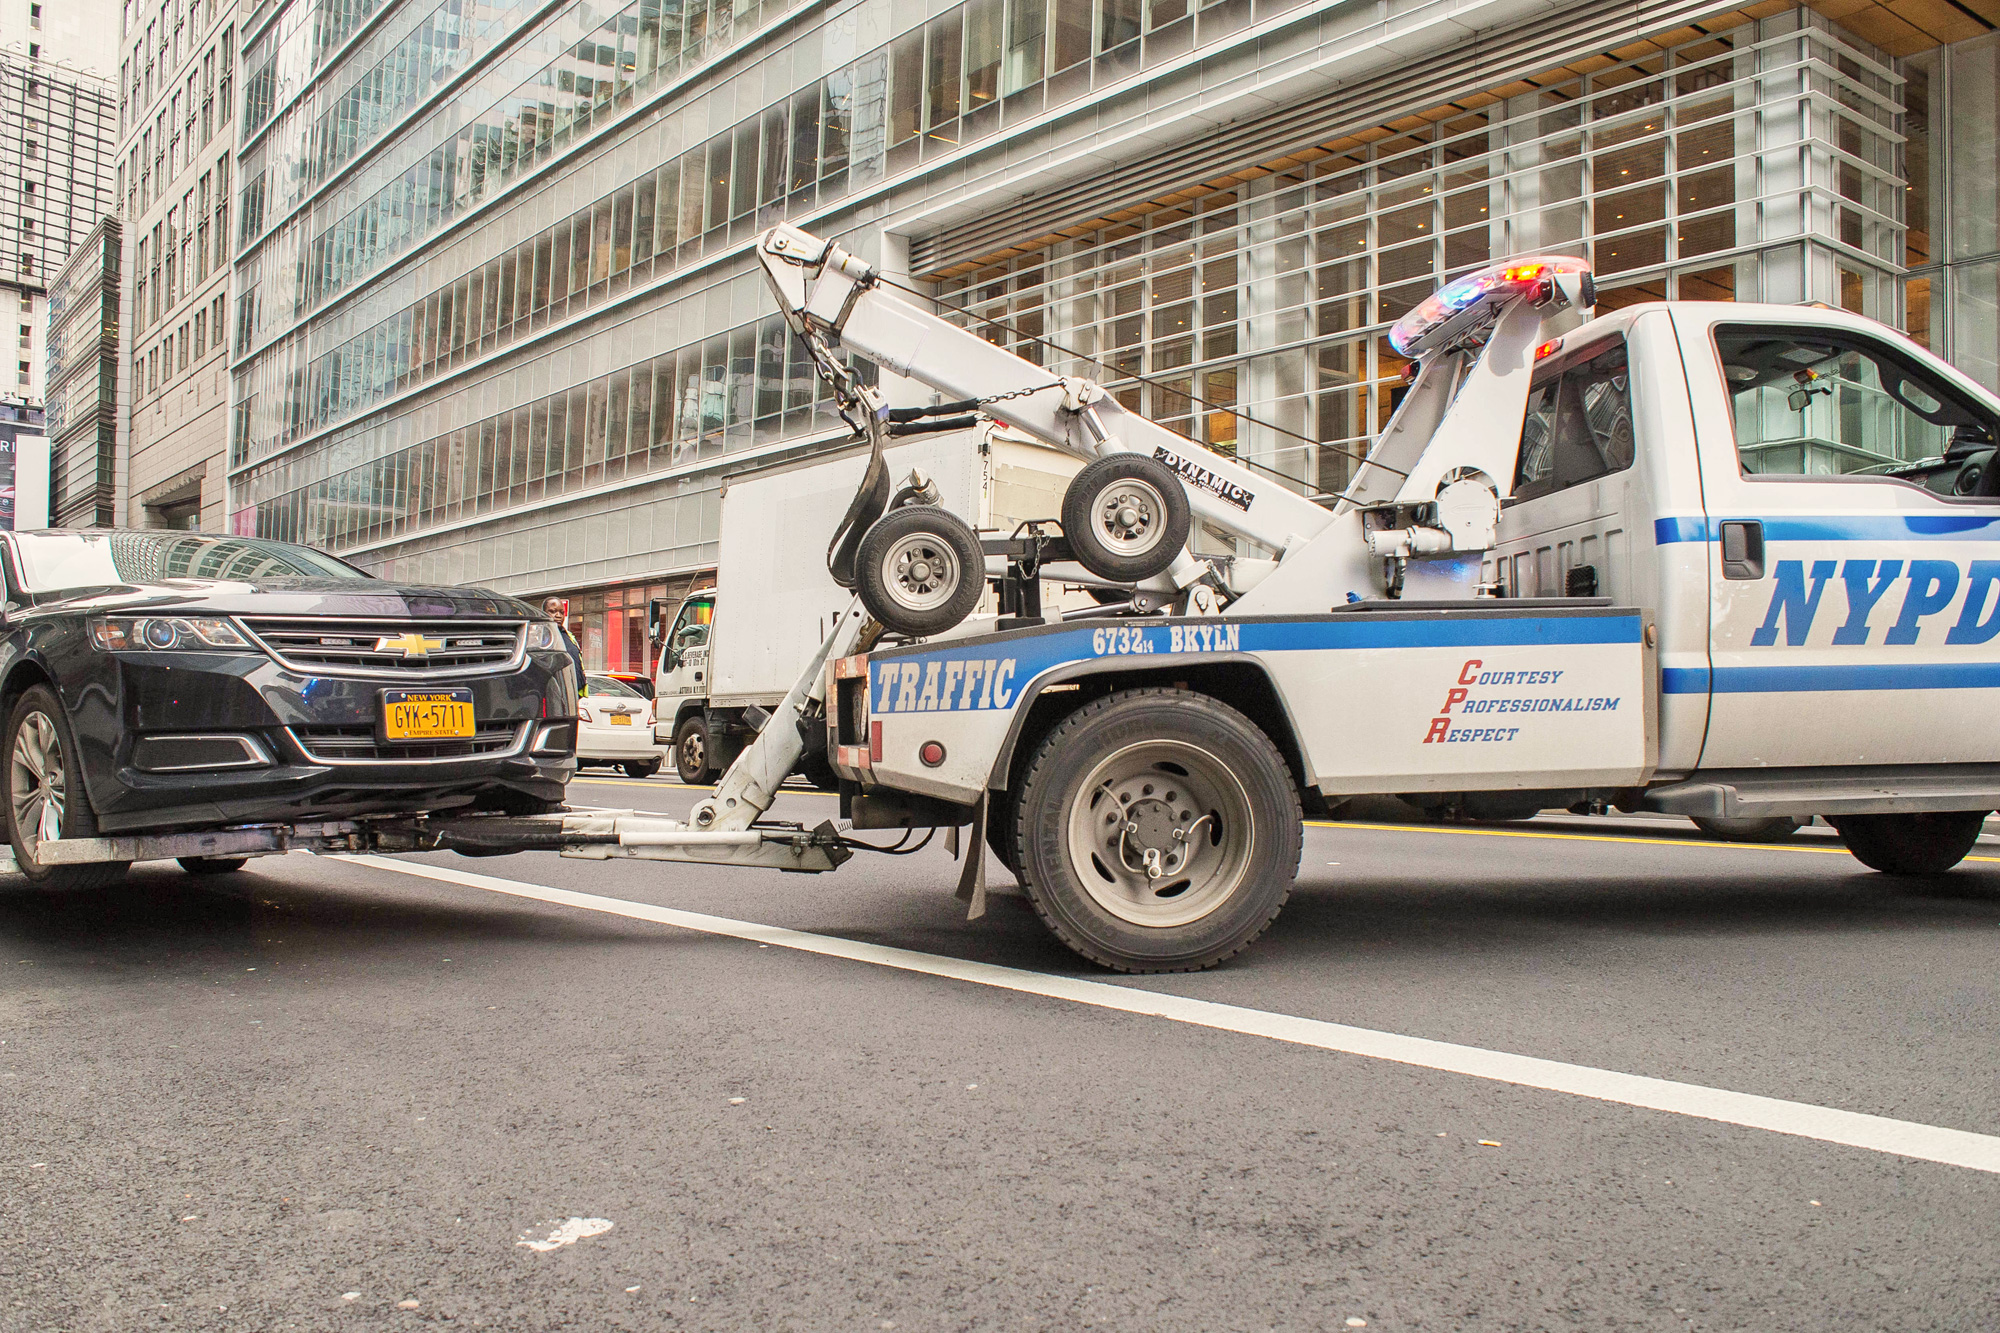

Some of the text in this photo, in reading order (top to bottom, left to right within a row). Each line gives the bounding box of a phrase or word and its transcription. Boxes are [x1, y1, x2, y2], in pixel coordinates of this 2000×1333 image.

[1164, 452, 1244, 499] DYNAMIC
[1750, 559, 2000, 647] NYPD
[1093, 627, 1143, 655] 6732
[1170, 624, 1240, 652] BKYLN
[877, 658, 1016, 713] TRAFFIC
[1457, 660, 1563, 685] COURTESY
[407, 693, 452, 702] NEW YORK
[1440, 688, 1620, 714] PROFESSIONALISM
[395, 704, 464, 728] GYK 5711
[1423, 717, 1519, 744] RESPECT
